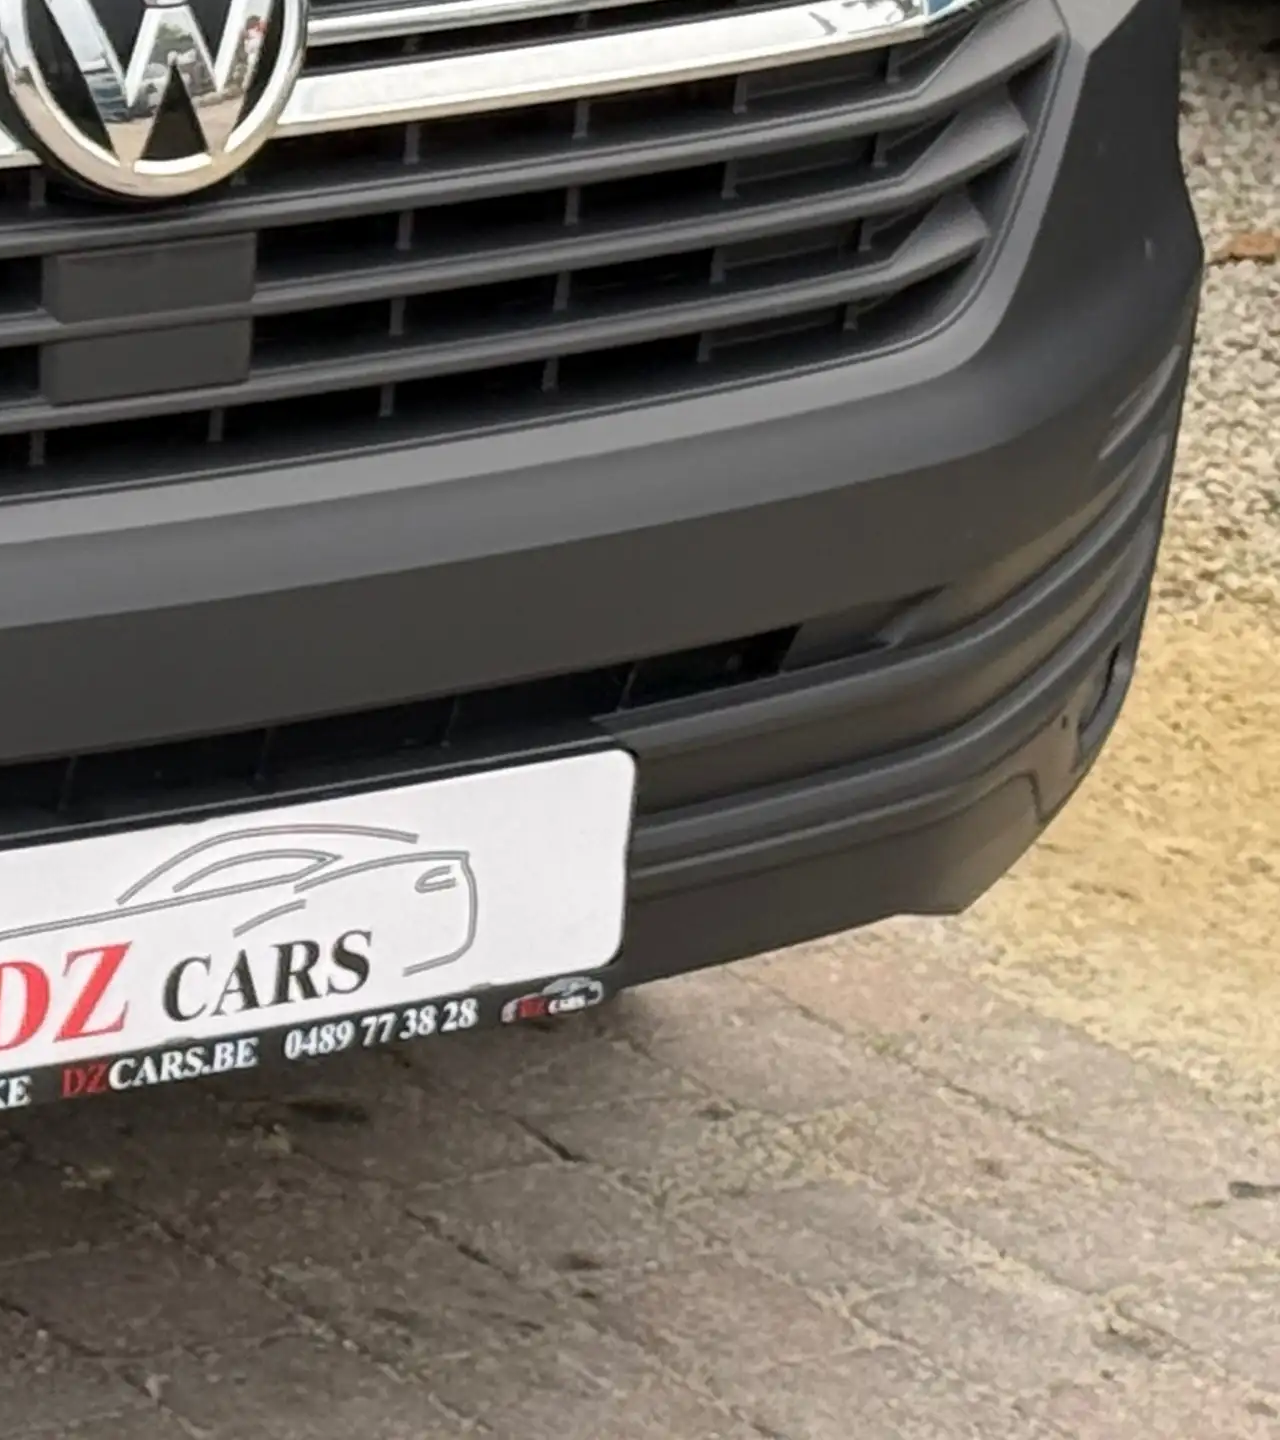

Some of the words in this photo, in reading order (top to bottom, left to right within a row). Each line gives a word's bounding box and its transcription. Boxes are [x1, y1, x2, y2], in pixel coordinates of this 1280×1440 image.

[162, 929, 372, 1022] CARS
[284, 1022, 357, 1060] 0489
[359, 1012, 394, 1047] 77
[399, 1004, 439, 1040] 38
[442, 997, 480, 1032] 28
